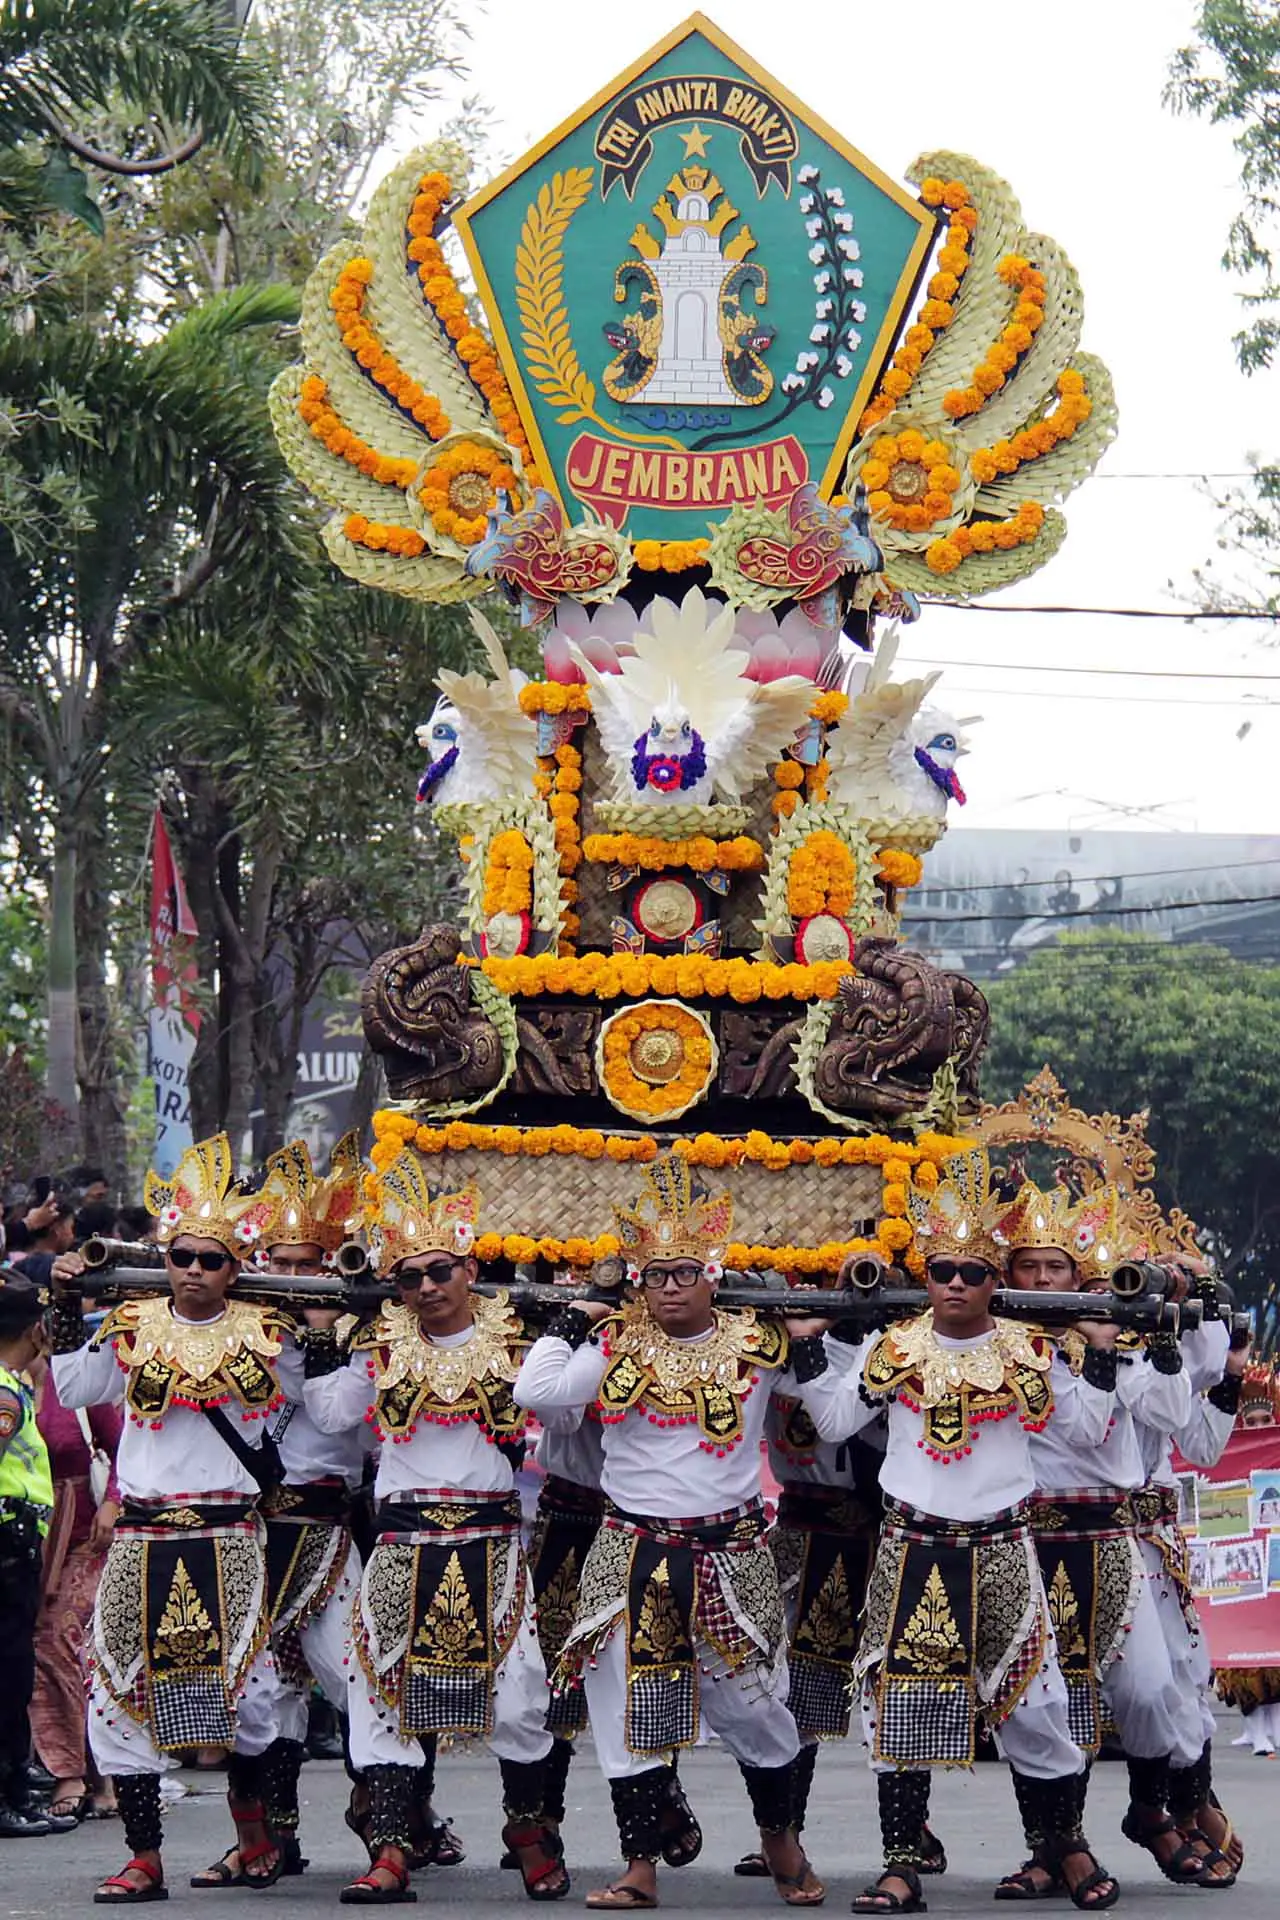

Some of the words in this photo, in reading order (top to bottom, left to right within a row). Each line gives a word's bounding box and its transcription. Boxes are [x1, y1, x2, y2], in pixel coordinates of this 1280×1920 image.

[598, 117, 640, 158] TRI
[634, 82, 718, 126] ANANTA
[721, 87, 794, 155] BHAKTI
[570, 443, 801, 502] JEMBRANA
[152, 1056, 187, 1087] KOT
